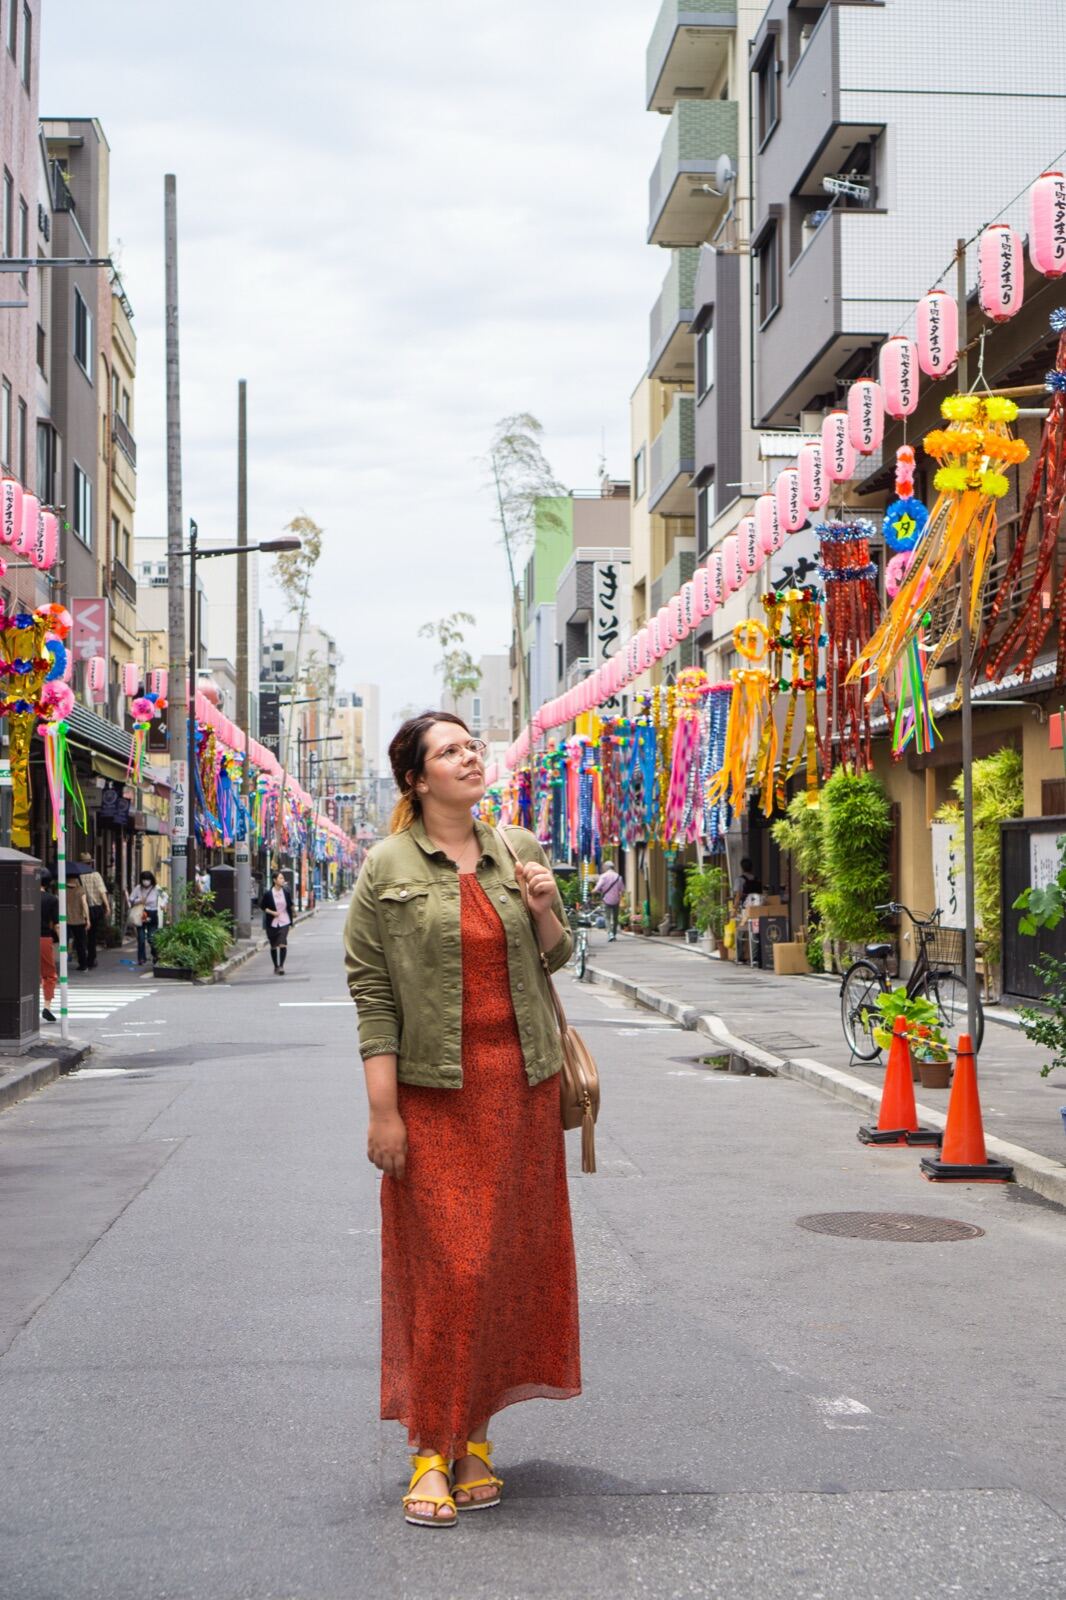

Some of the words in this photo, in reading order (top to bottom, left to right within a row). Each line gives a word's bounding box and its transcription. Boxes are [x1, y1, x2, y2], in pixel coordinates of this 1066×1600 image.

[1000, 233, 1013, 305] 下町七夕まつり
[929, 299, 940, 367] 下町七夕まつり
[901, 345, 911, 407] 下町七夕まつり
[863, 387, 873, 445] 下町七夕まつり
